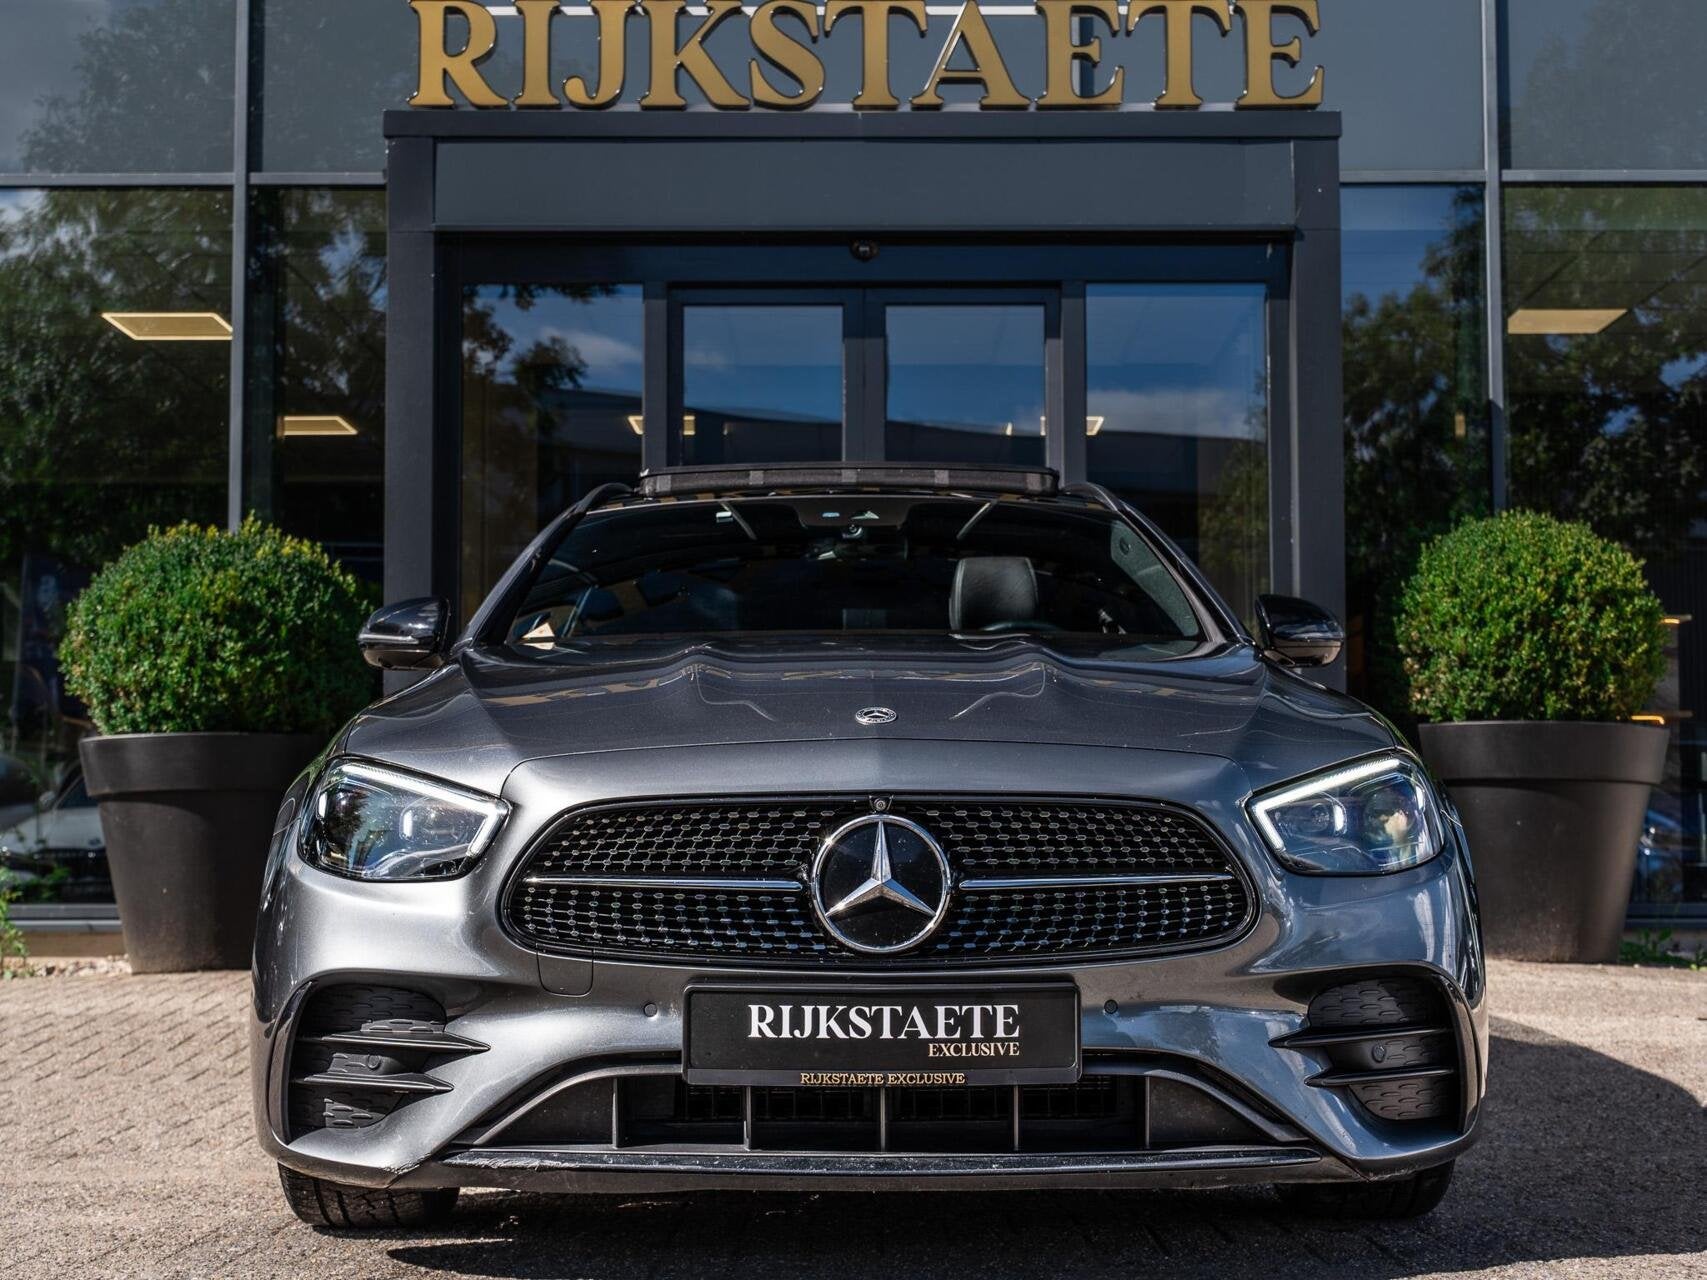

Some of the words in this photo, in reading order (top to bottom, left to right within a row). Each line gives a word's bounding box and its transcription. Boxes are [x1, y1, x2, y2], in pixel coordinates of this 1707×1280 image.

[408, 0, 1324, 109] RIJKSTAETE
[748, 1004, 1020, 1039] RIJKSTAETE
[928, 1042, 1020, 1057] EXCLUSIVE
[800, 1073, 884, 1085] RIJKSTAETE
[888, 1073, 966, 1085] EXCLUSIVE
